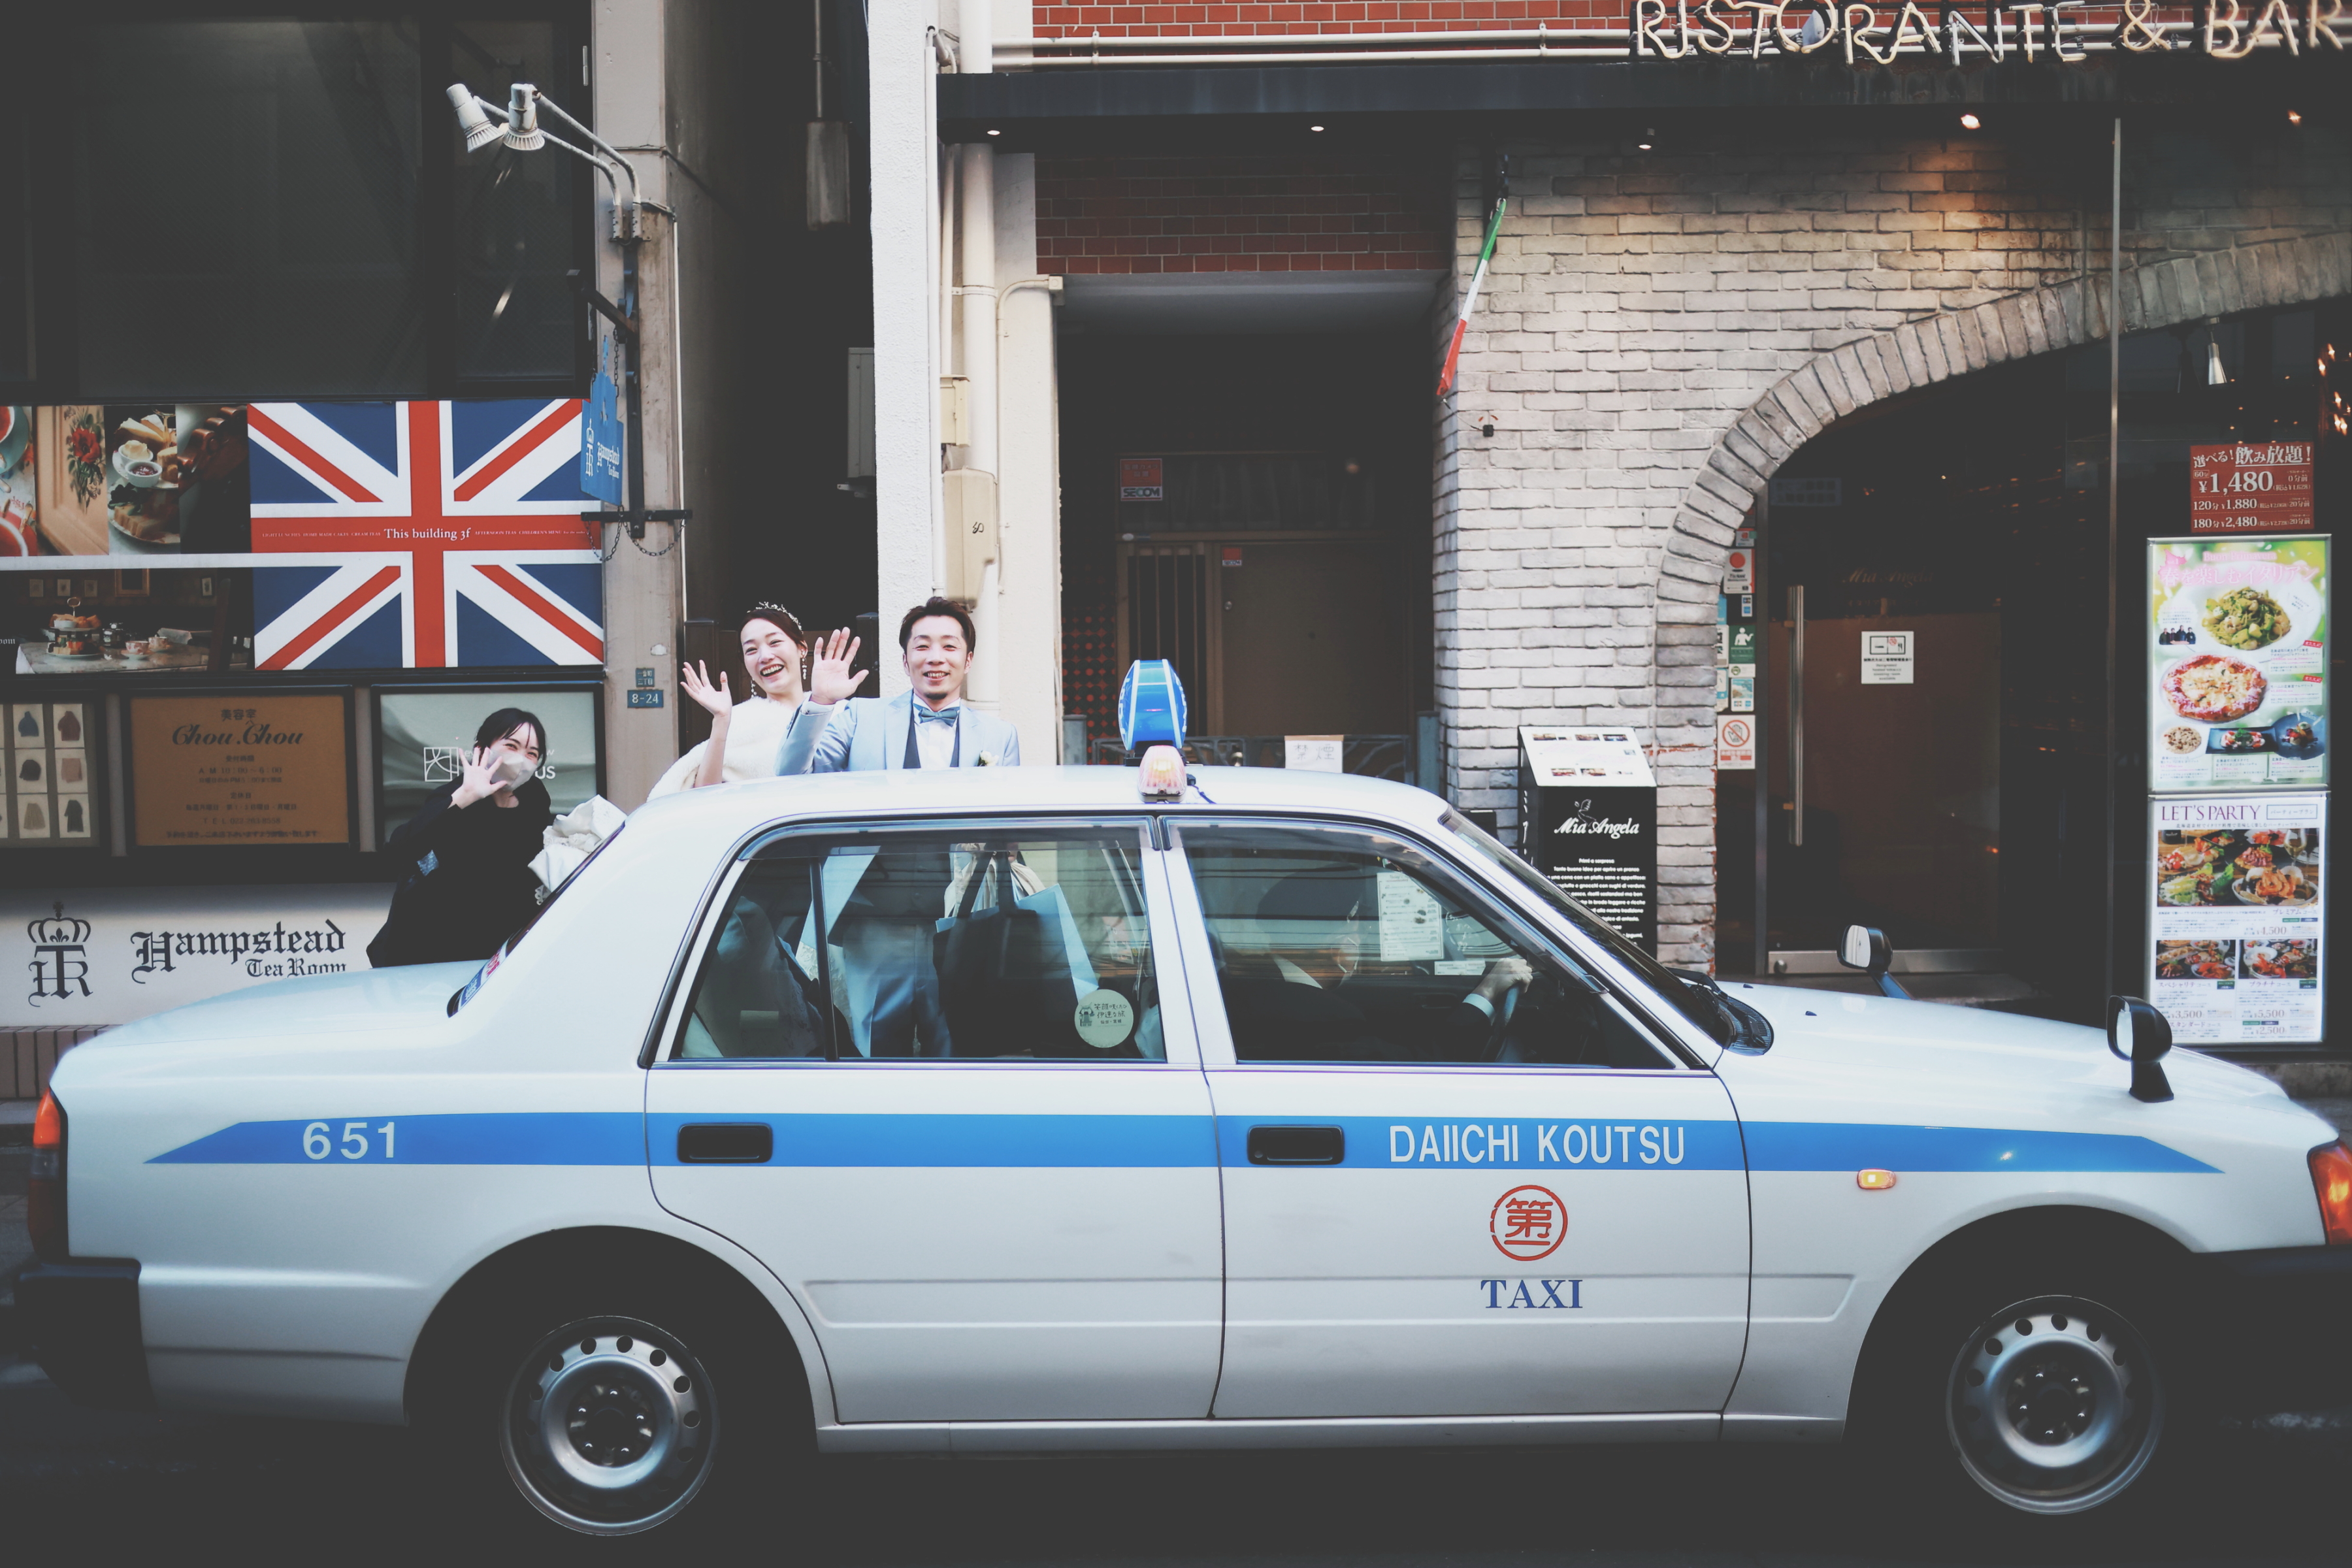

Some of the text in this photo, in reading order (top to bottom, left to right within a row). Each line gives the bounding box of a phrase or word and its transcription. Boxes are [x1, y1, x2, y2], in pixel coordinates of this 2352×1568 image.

[1635, 0, 2344, 66] RISTORANTE & BAR
[1123, 487, 1160, 497] SECOM
[384, 528, 410, 538] This
[412, 528, 457, 541] building
[460, 527, 472, 541] 3f
[2204, 551, 2276, 561] Buon Primavera
[2163, 564, 2319, 587] 春を楽しむイタリアン
[632, 693, 659, 704] 8-24
[221, 709, 256, 721] 美容室
[1294, 743, 1334, 761] 禁煙
[2161, 805, 2261, 821] LET'S PARTY
[1554, 817, 1640, 840] Mia Angela
[131, 919, 346, 984] Hampstead
[245, 957, 347, 978] Tea Room
[302, 1121, 395, 1160] 651
[1389, 1124, 1685, 1165] DAIICHI KOUTSU
[1480, 1279, 1584, 1310] TAXI
